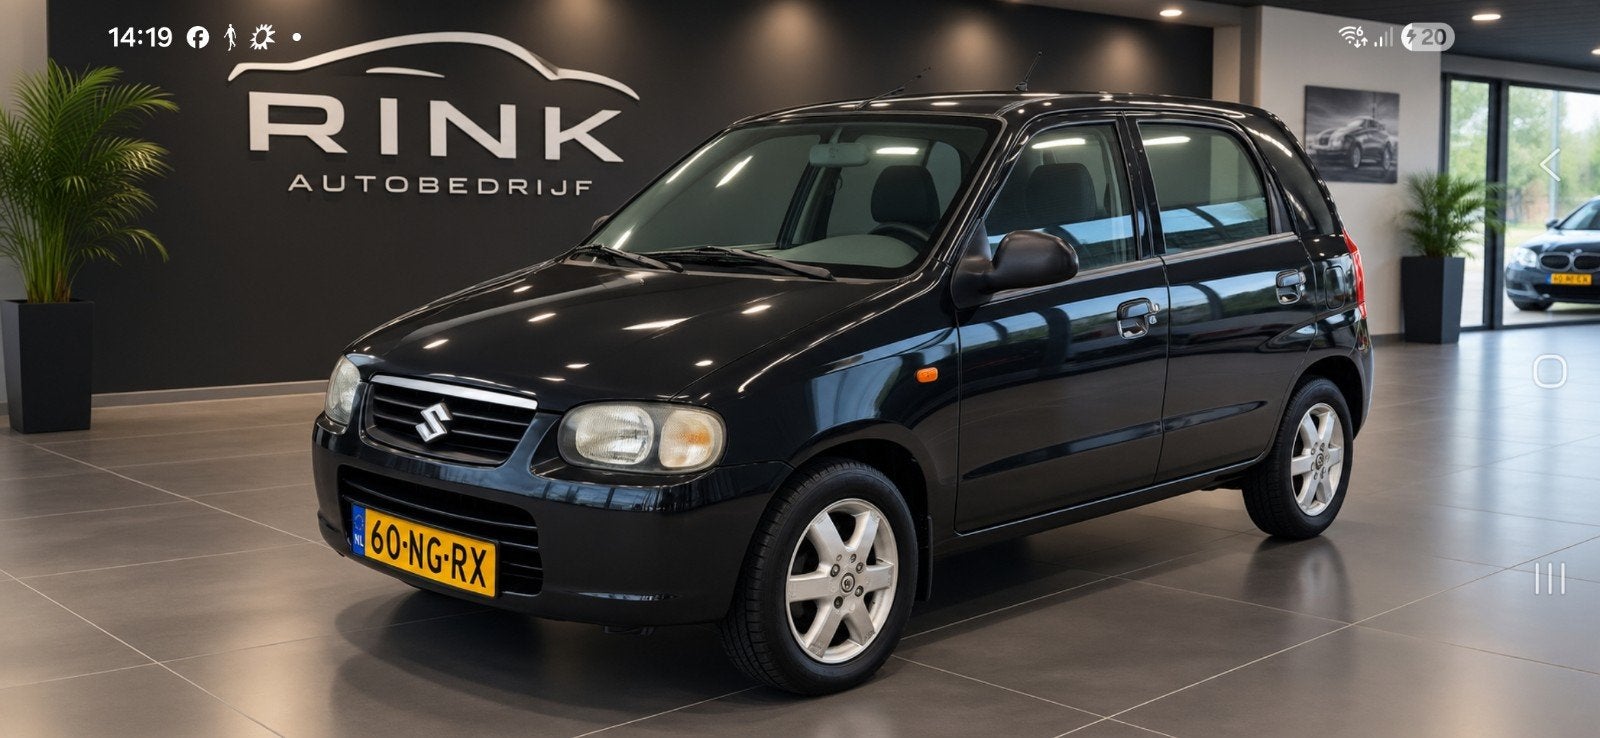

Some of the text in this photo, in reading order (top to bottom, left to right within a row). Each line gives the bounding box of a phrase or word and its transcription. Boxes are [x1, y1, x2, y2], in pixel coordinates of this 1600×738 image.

[249, 91, 623, 162] RINK
[288, 173, 592, 196] AUTOBEDRIJF
[354, 534, 364, 547] NL
